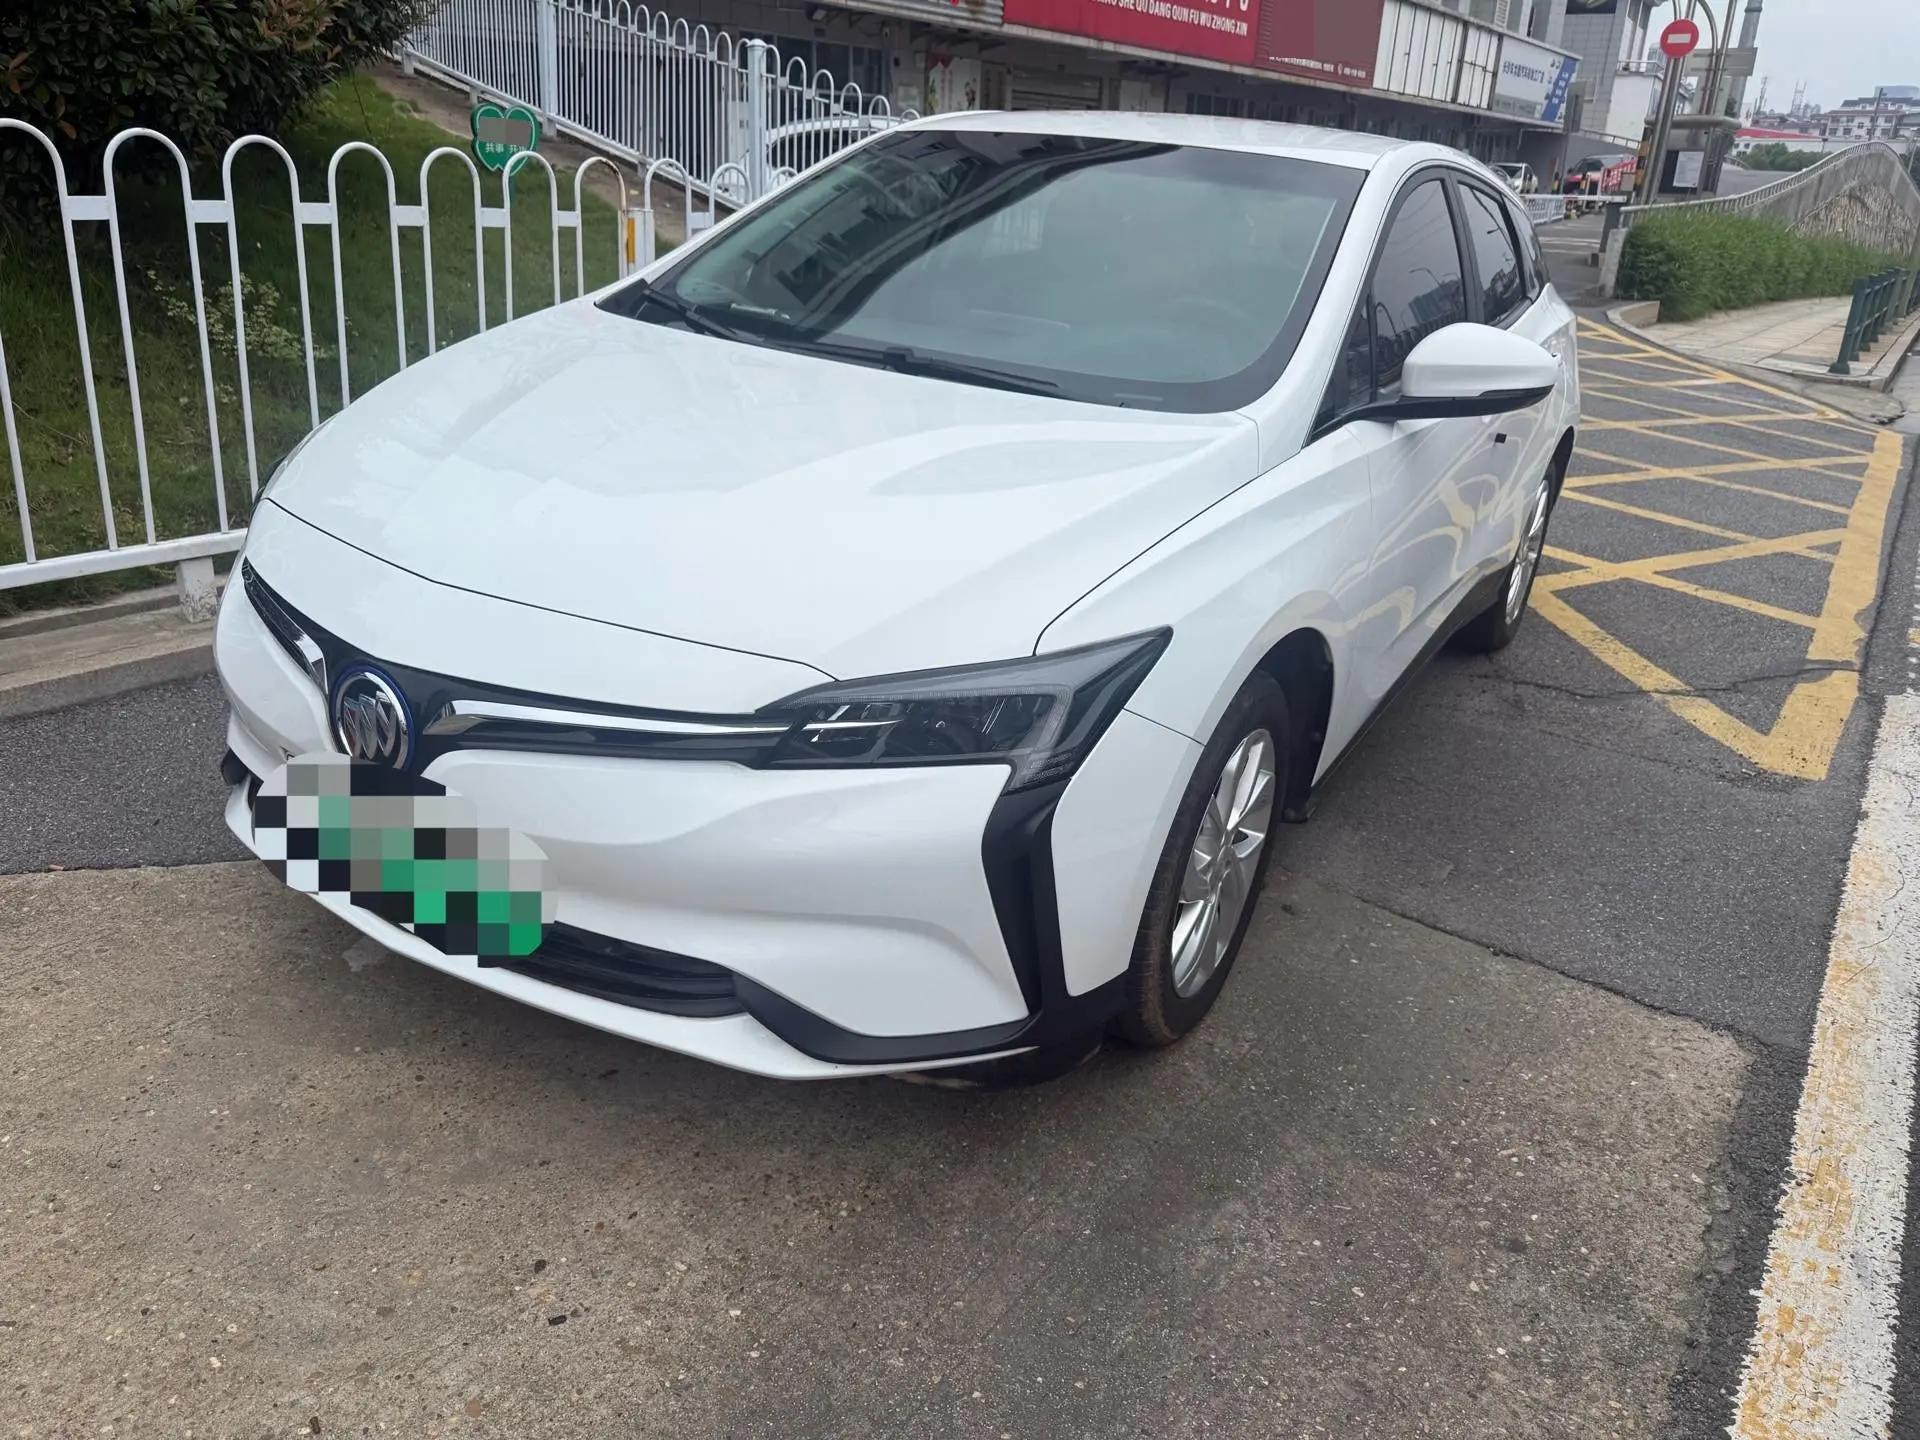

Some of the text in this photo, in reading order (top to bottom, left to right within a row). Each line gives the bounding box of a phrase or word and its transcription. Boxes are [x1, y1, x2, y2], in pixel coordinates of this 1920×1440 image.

[1136, 0, 1148, 13] QU
[1149, 0, 1171, 19] DANG
[1172, 5, 1189, 22] QUN
[1190, 8, 1200, 25] FU
[1200, 11, 1212, 28] WU
[1212, 14, 1235, 34] ZHONG
[1236, 21, 1248, 37] XIN
